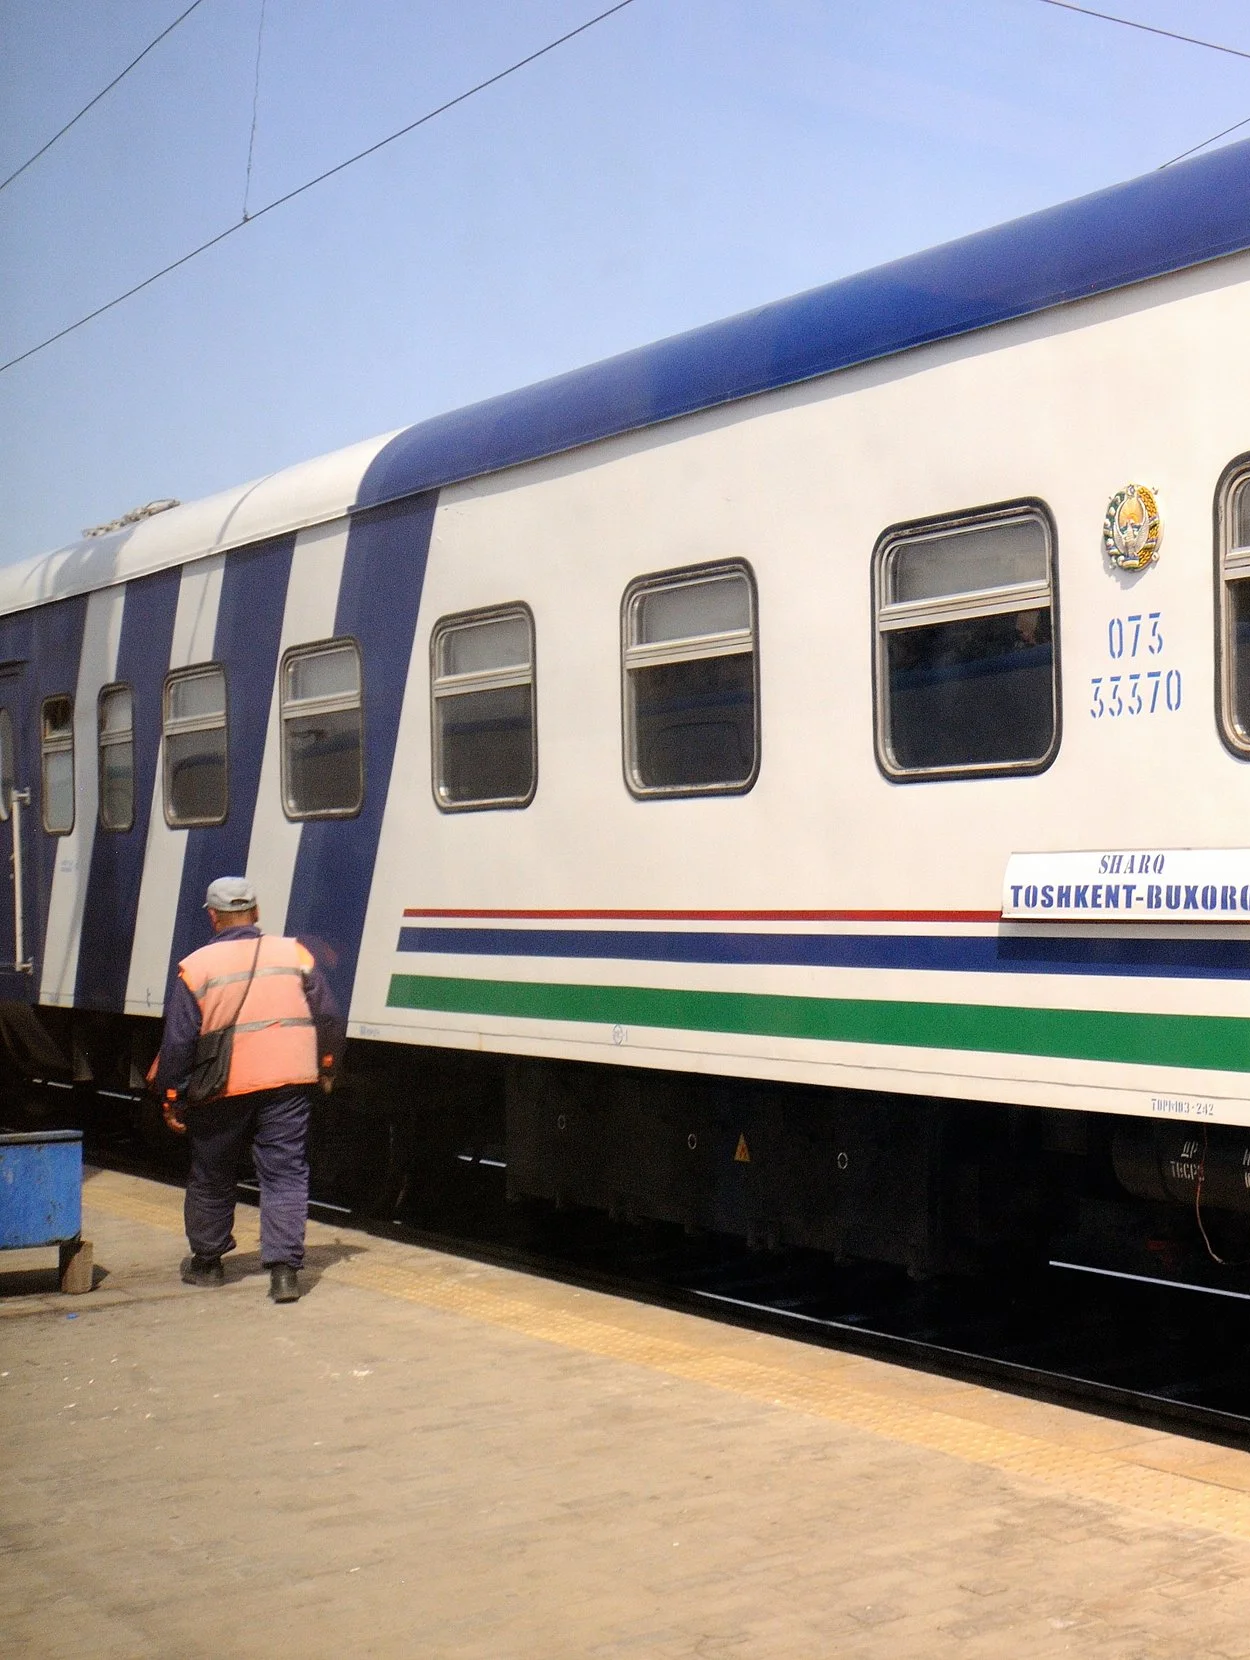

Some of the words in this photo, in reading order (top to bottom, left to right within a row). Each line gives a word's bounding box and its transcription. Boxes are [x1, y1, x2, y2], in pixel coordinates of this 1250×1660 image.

[1108, 612, 1163, 659] 073
[1090, 669, 1181, 718] 33370
[1098, 854, 1165, 874] SHARQ
